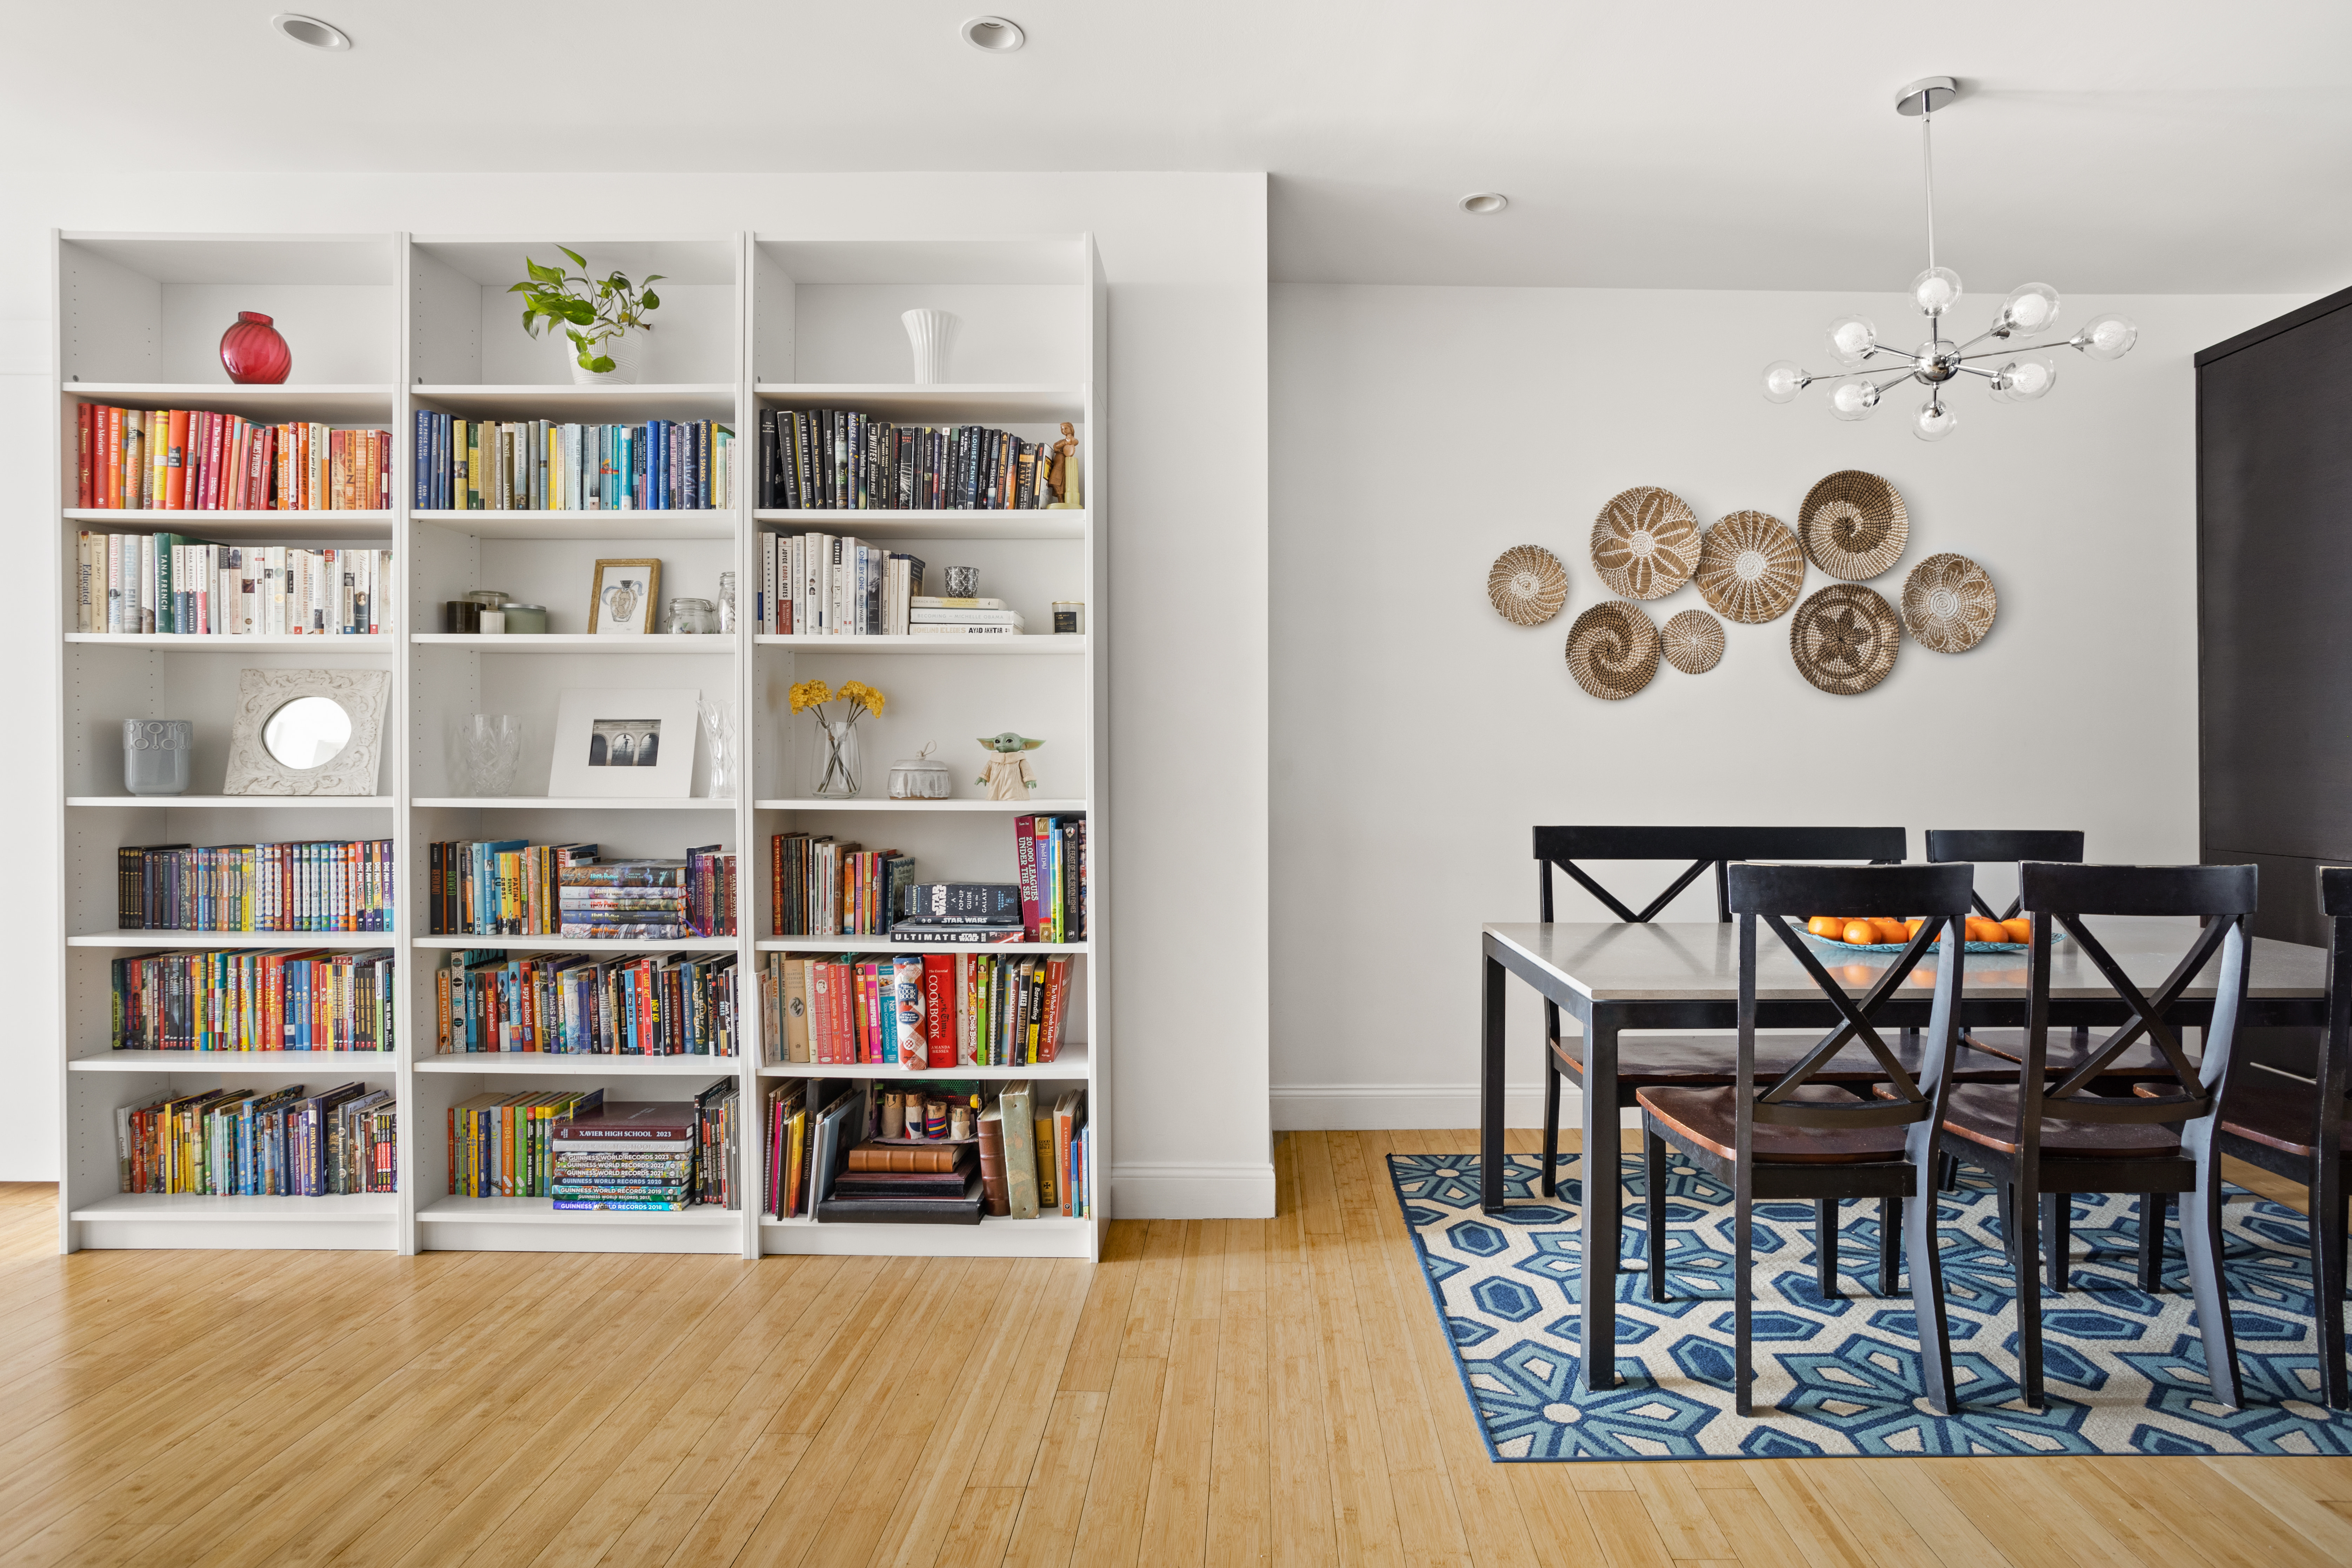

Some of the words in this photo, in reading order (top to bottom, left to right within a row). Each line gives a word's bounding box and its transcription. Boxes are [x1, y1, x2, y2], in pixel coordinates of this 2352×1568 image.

[83, 564, 91, 605] Educated
[859, 566, 865, 575] BY
[1019, 838, 1027, 866] UNDER
[432, 869, 440, 894] REBOUND
[447, 871, 456, 895] BOOKED
[1028, 864, 1038, 900] LEAGUES
[937, 885, 946, 915] WARS
[929, 975, 939, 1038] COOKBOOK
[1031, 987, 1040, 1020] Bartending
[1042, 984, 1051, 1042] COOKBOOK
[803, 1147, 812, 1180] University
